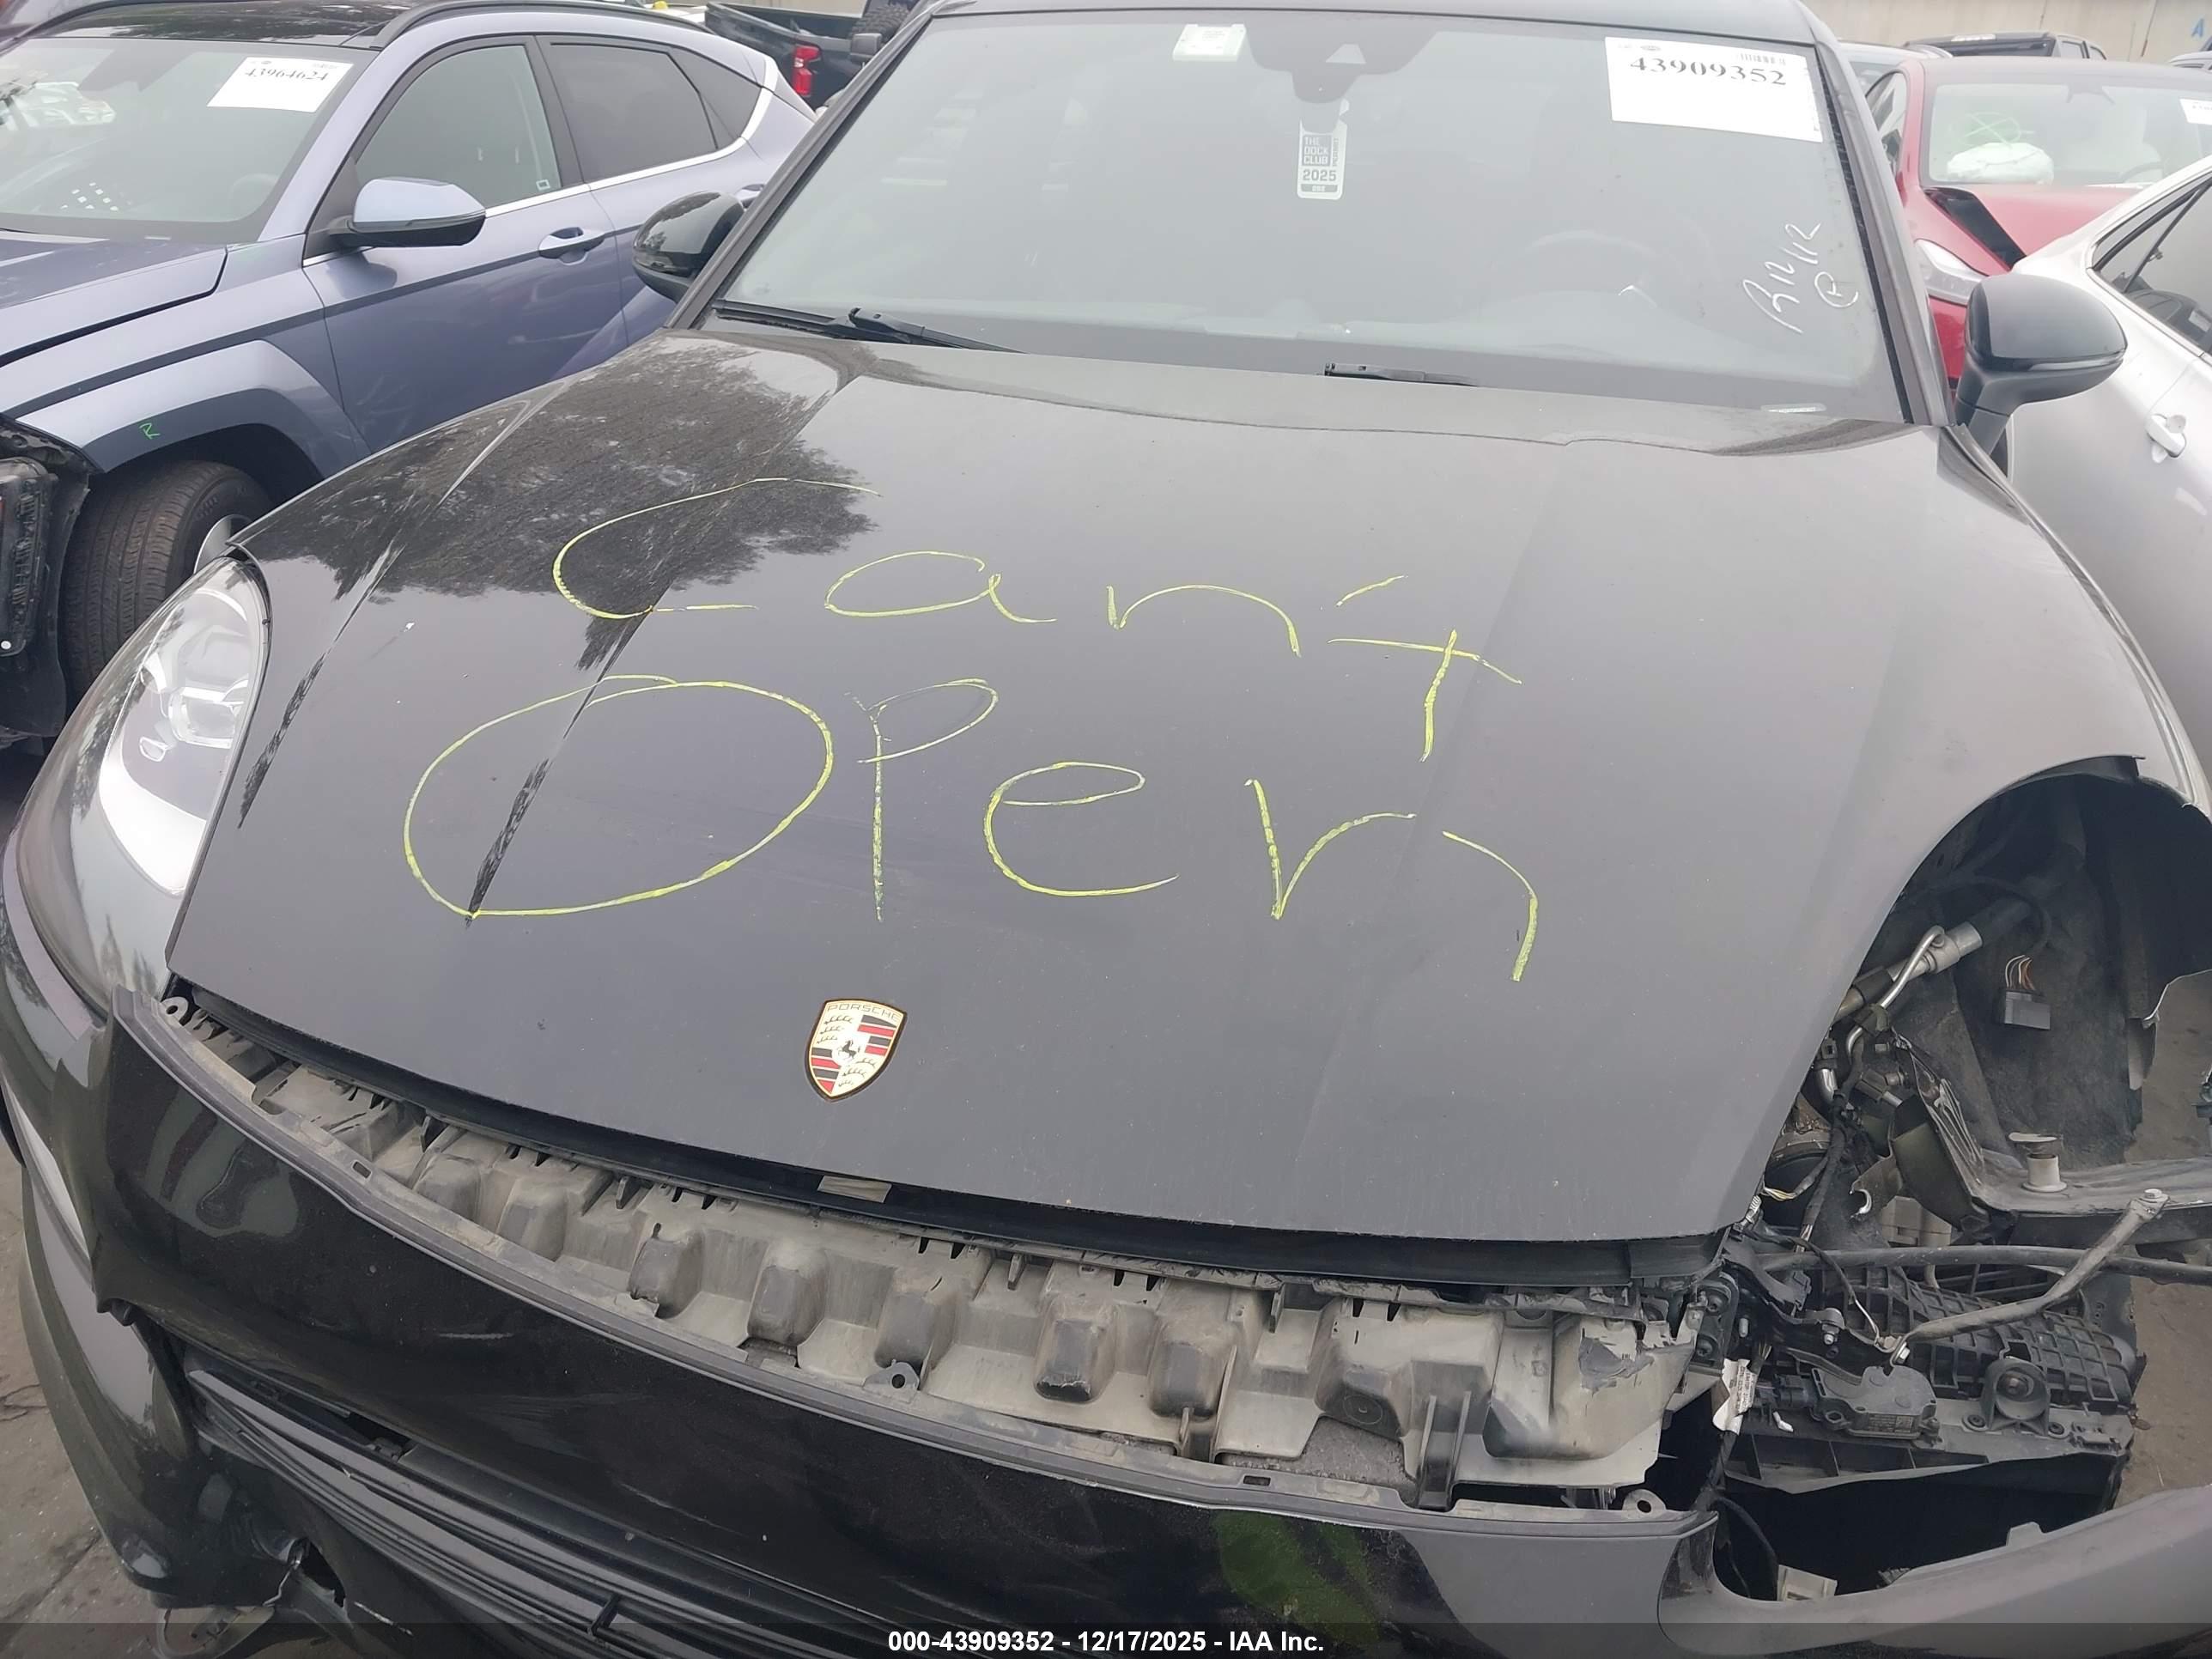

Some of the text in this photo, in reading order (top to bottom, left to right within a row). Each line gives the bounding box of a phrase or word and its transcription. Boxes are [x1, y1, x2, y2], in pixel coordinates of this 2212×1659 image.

[245, 67, 330, 82] 43964624
[1630, 56, 1787, 86] 43909352
[1304, 146, 1328, 155] DOCK
[1304, 155, 1328, 165] CLUB
[1303, 169, 1337, 181] 2025
[827, 1003, 902, 1022] PORSCHE
